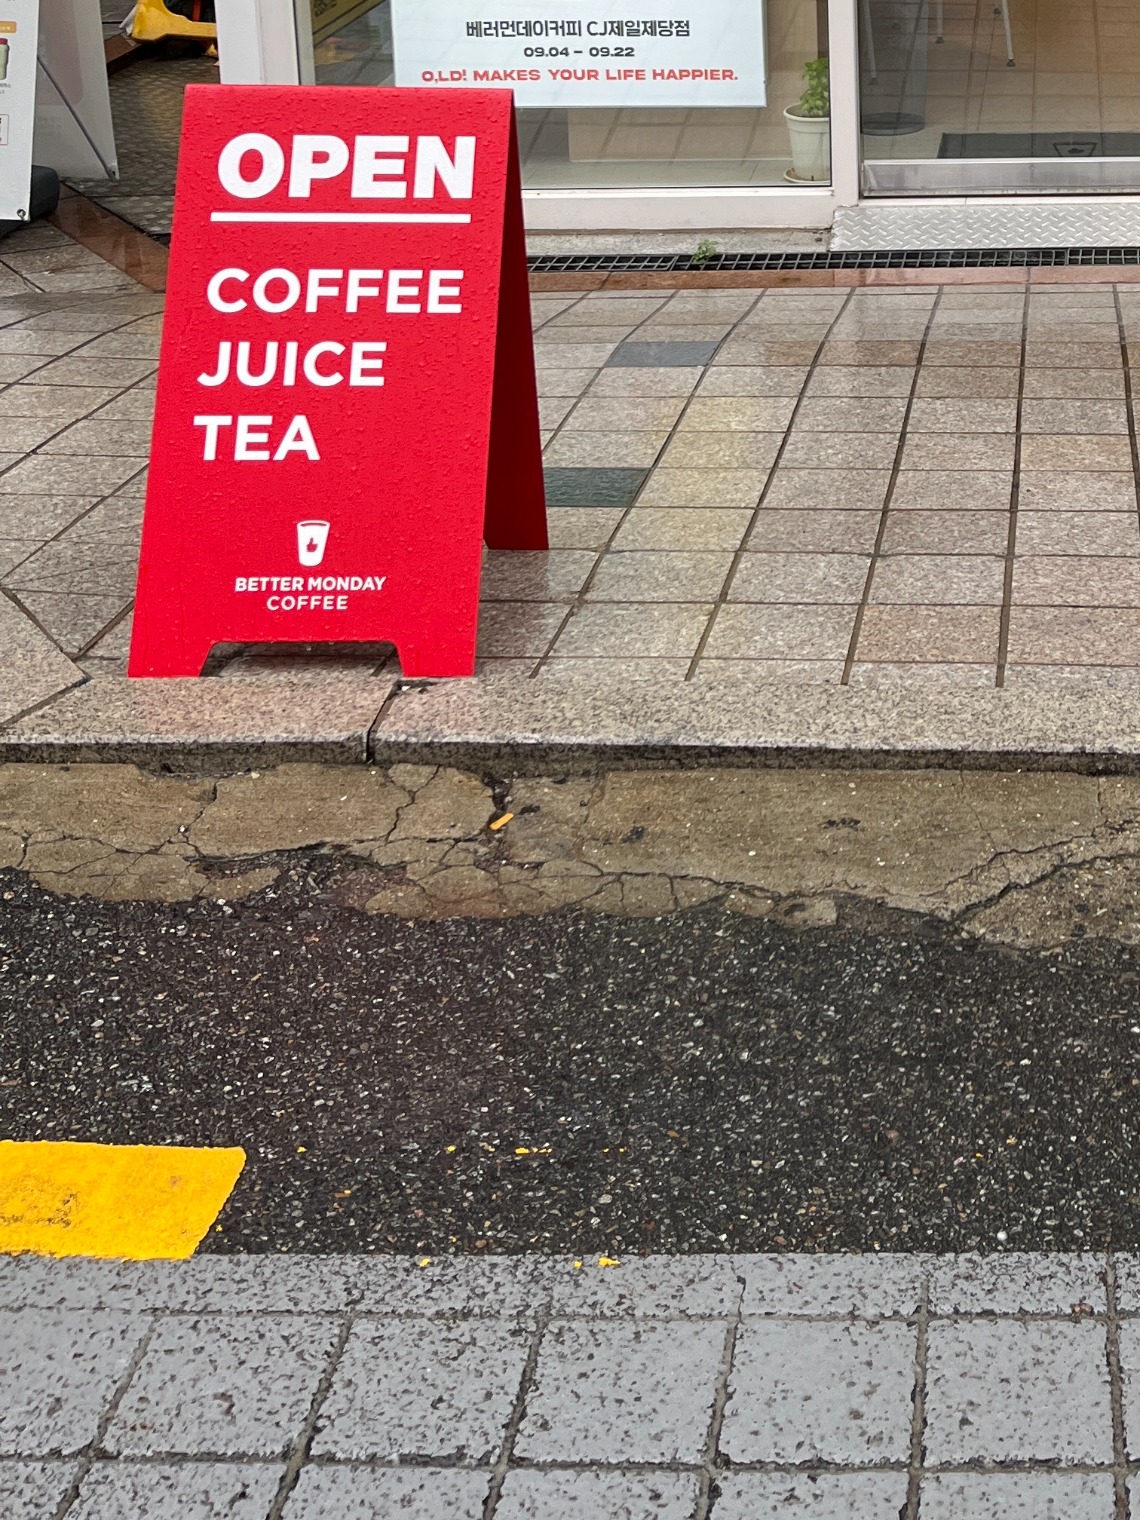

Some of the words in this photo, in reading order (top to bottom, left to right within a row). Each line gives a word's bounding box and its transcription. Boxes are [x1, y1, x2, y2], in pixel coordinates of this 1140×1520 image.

[465, 20, 581, 38] 베러먼데이커피
[587, 20, 690, 38] CJ제일제당점
[523, 46, 570, 58] 09.04
[588, 46, 635, 58] 09.22
[421, 68, 467, 84] O,LD!
[473, 69, 541, 82] MAKES
[548, 69, 600, 82] YOUR
[605, 69, 646, 82] LIFE
[652, 69, 739, 82] HAPPIER.
[216, 132, 477, 200] OPEN
[206, 267, 466, 315] COFFEE
[196, 341, 388, 388] JUICE
[192, 413, 321, 462] TEA
[234, 576, 304, 592] BETTER
[307, 576, 387, 592] MONDAY
[266, 595, 349, 612] COFFEE
